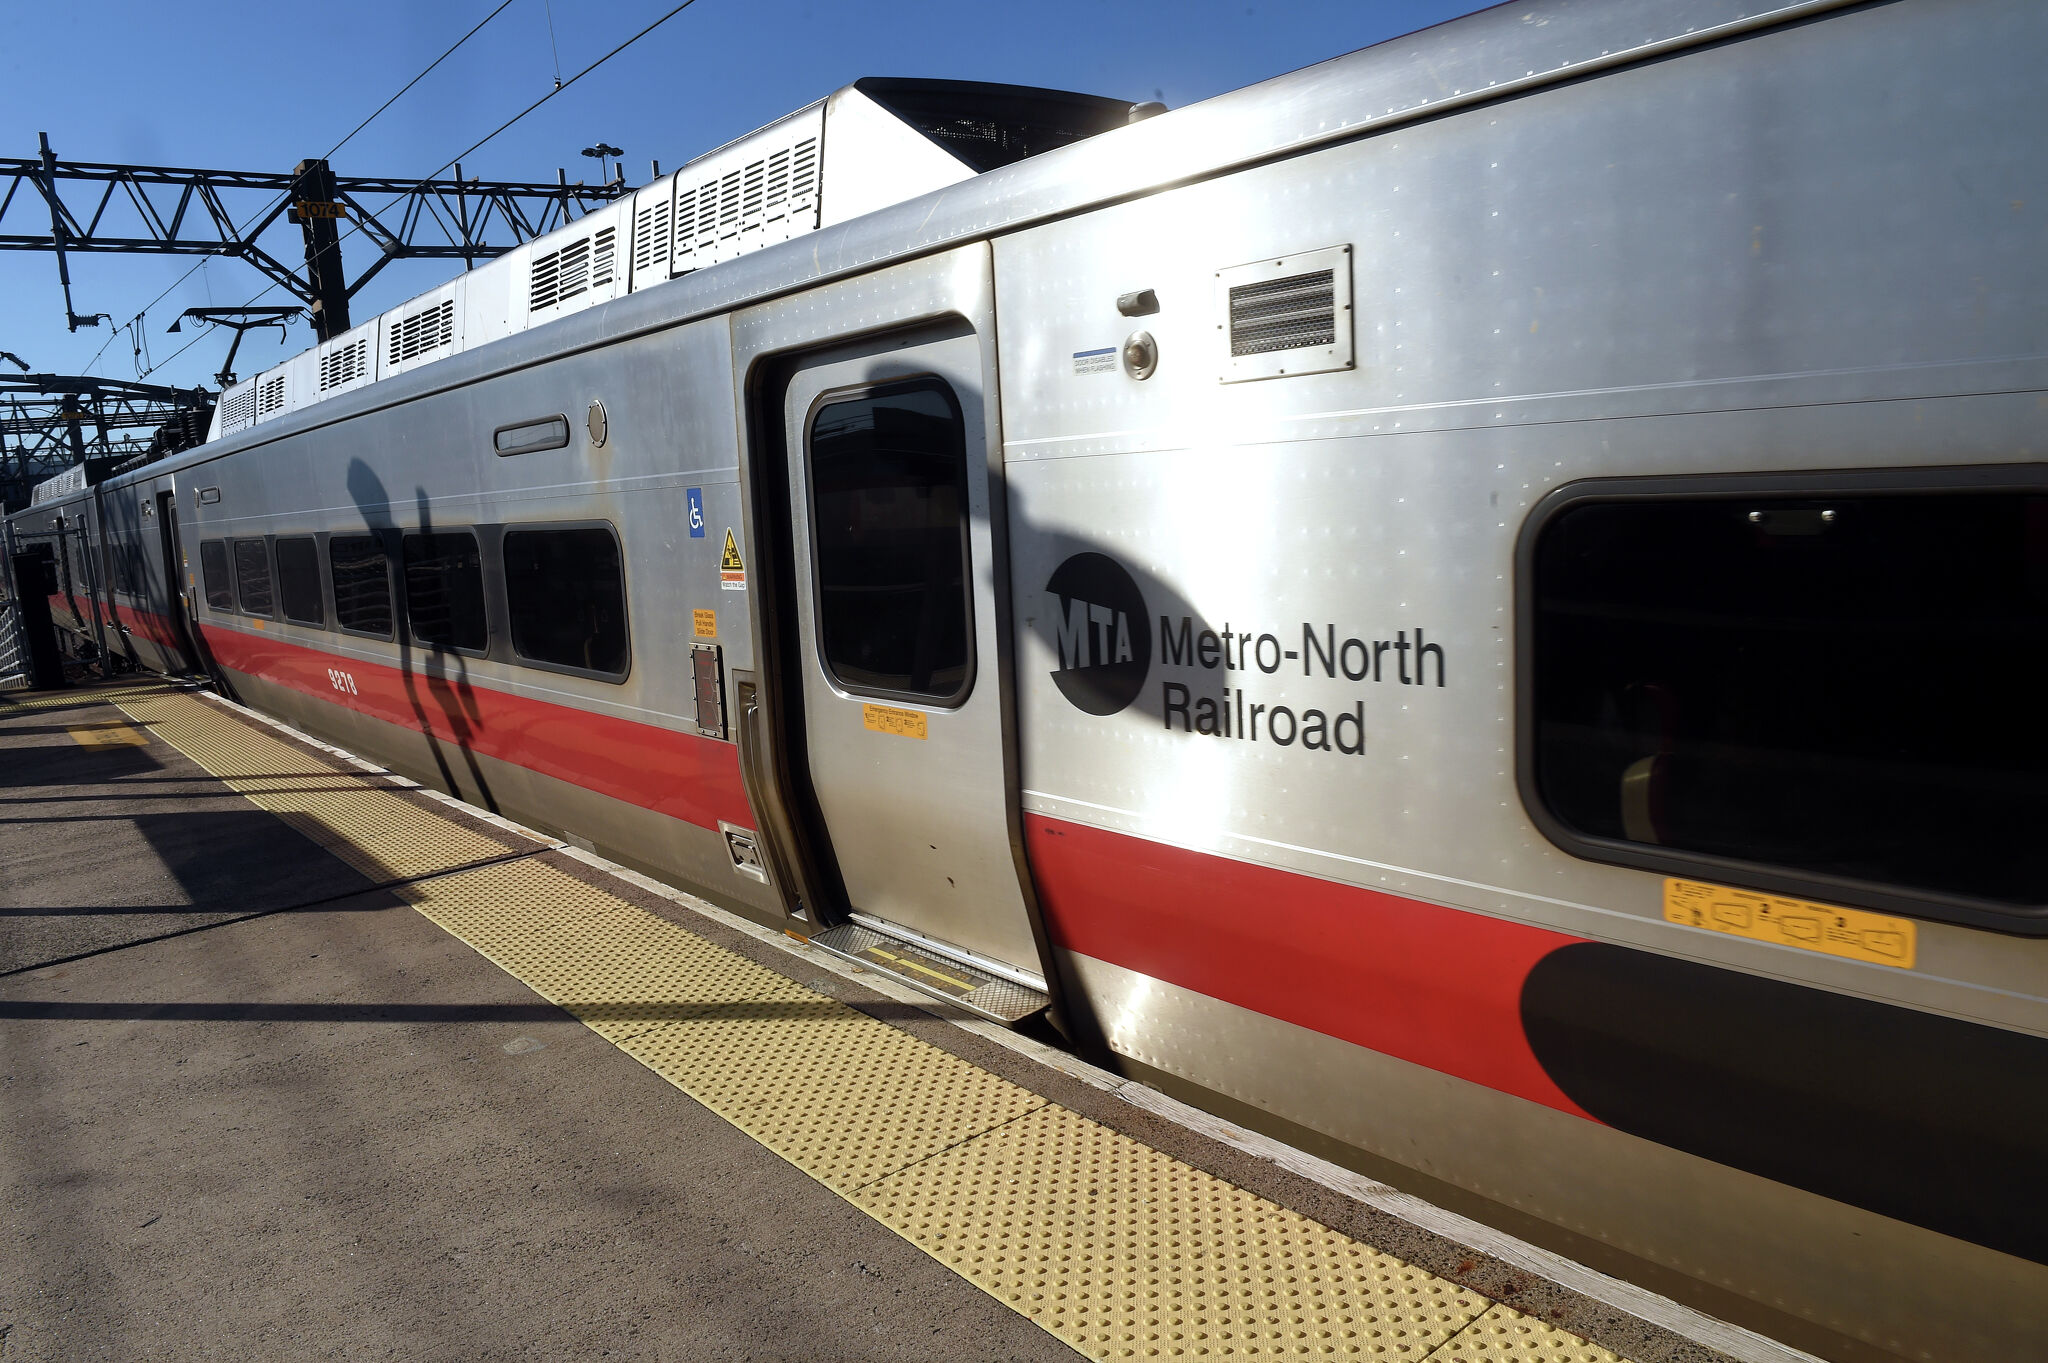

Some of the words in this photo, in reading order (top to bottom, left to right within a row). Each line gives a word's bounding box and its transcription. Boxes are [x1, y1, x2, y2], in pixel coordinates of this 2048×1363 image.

[301, 203, 339, 217] 1074
[1051, 592, 1134, 672] MTA
[1160, 614, 1446, 688] Metro-North
[327, 668, 358, 696] 9278
[869, 705, 889, 714] Emergency
[1162, 681, 1366, 756] Railroad
[1759, 902, 1770, 914] 2
[1835, 916, 1847, 928] 3
